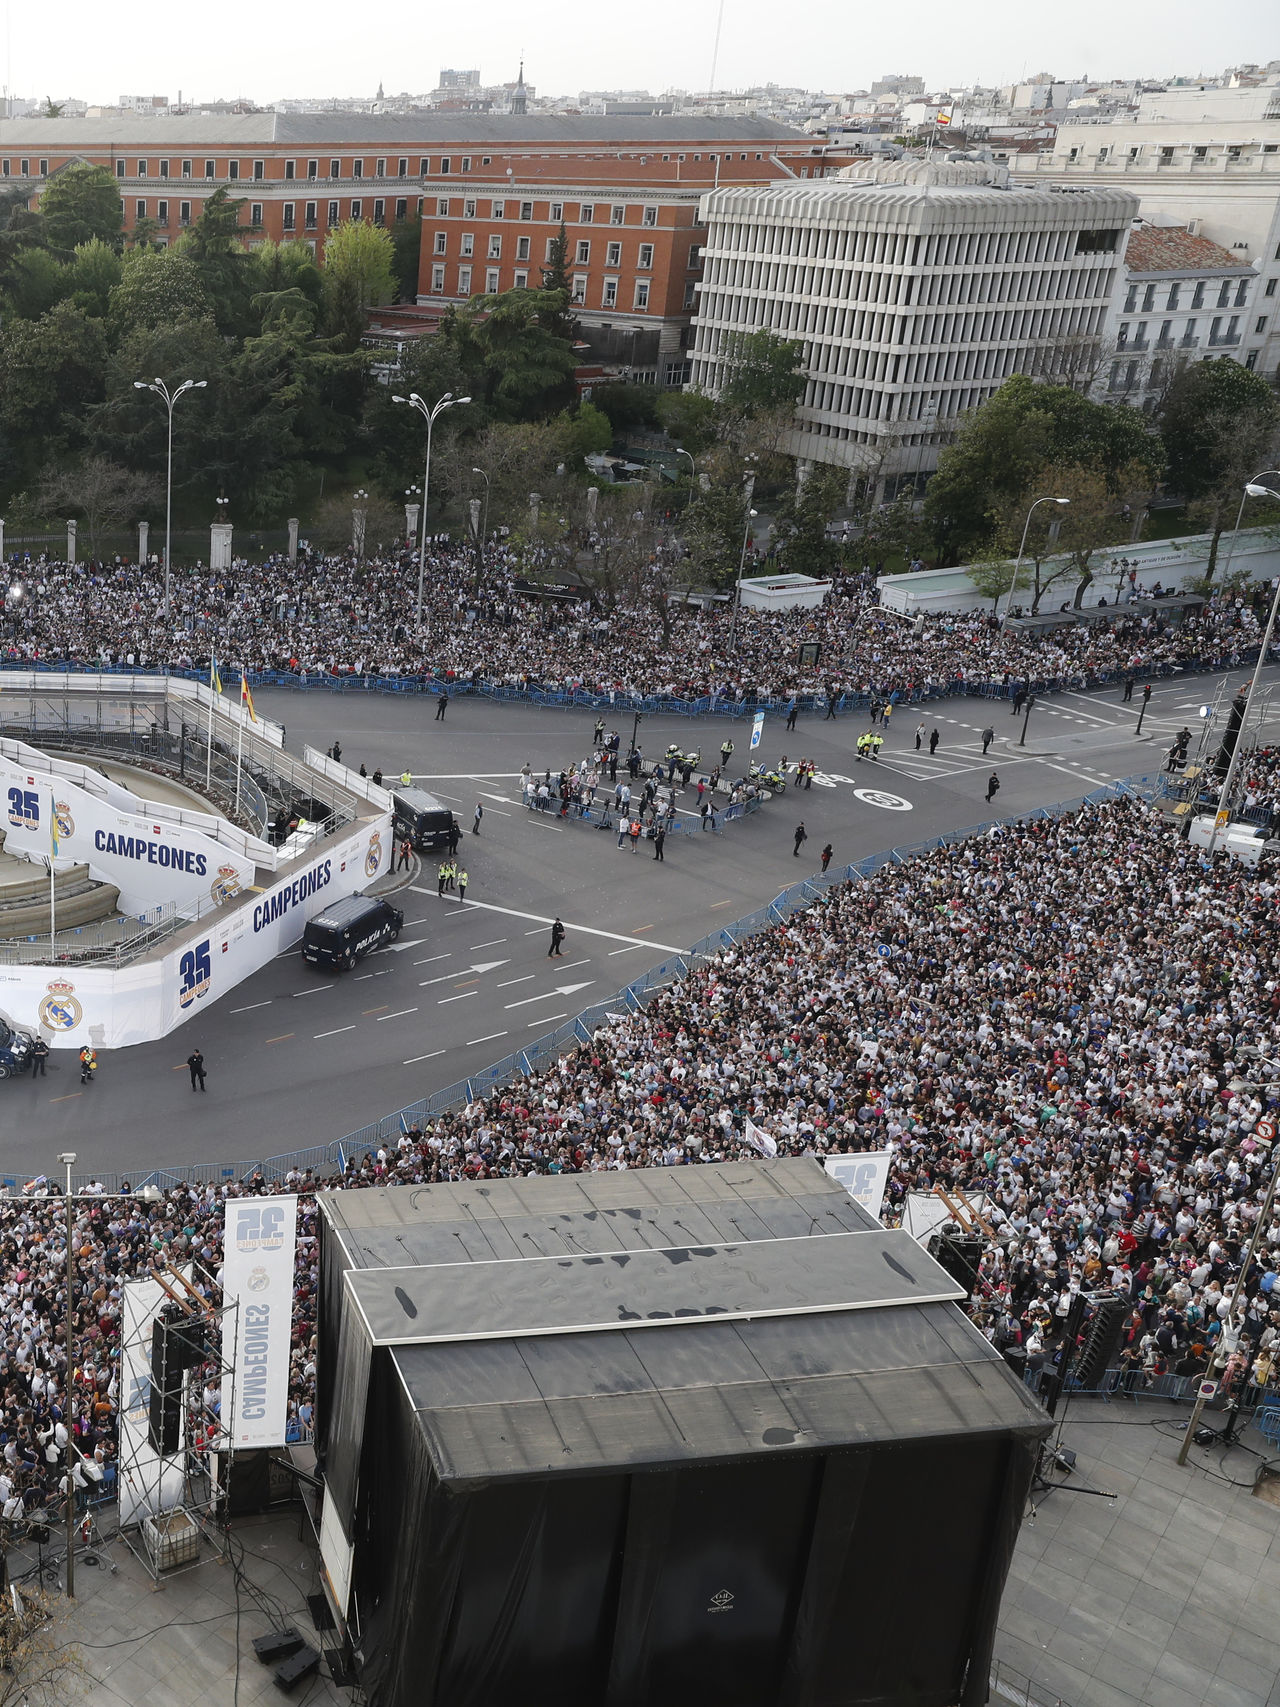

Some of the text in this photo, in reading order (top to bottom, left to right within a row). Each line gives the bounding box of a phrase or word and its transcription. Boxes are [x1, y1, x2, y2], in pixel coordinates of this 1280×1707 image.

[8, 787, 40, 832] 35
[8, 813, 40, 828] CAMPEONES
[95, 829, 207, 876] CAMPEONES
[253, 859, 332, 933] CAMPEONES
[180, 939, 211, 1009] 35
